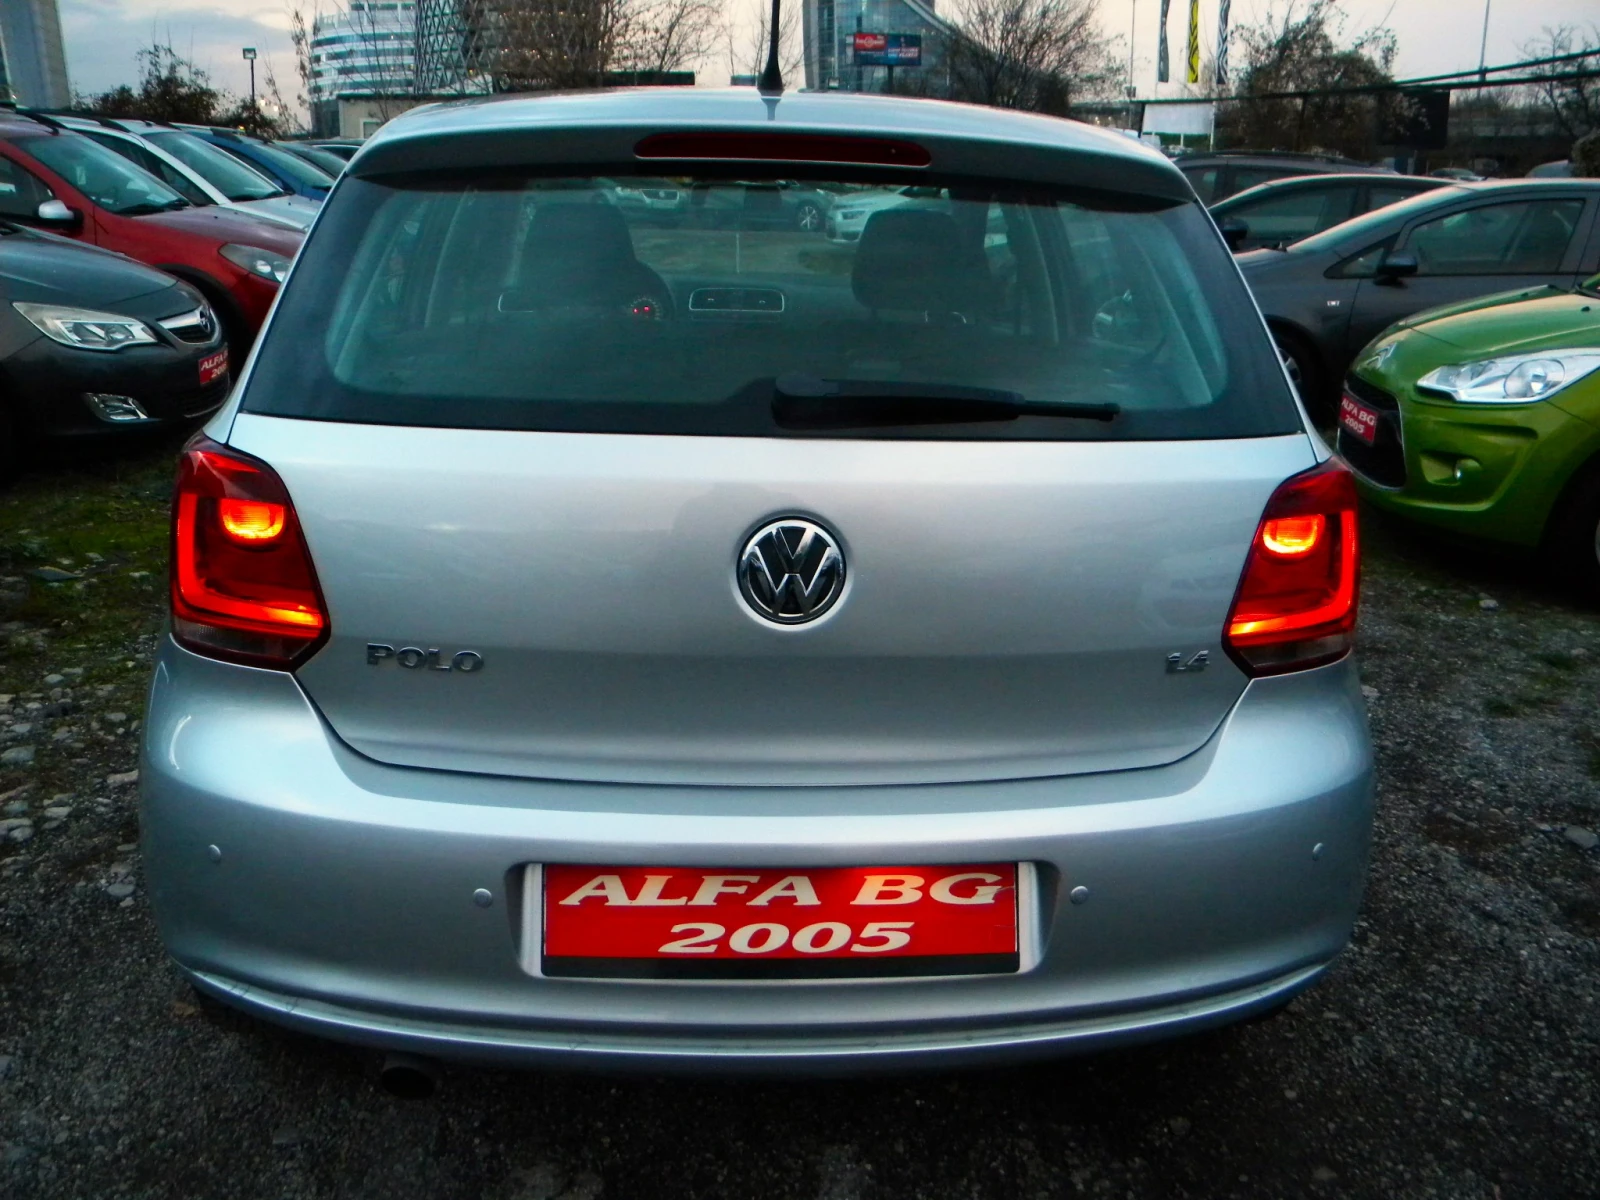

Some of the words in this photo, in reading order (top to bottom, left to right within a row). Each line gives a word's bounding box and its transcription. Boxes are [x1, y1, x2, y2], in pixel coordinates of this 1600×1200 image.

[1341, 398, 1359, 417] ALFA
[1358, 410, 1376, 426] BG
[1344, 414, 1365, 434] 2005
[366, 642, 485, 673] POLO
[558, 874, 822, 906] ALFA
[849, 872, 1003, 906] BG
[657, 921, 915, 954] 2005
